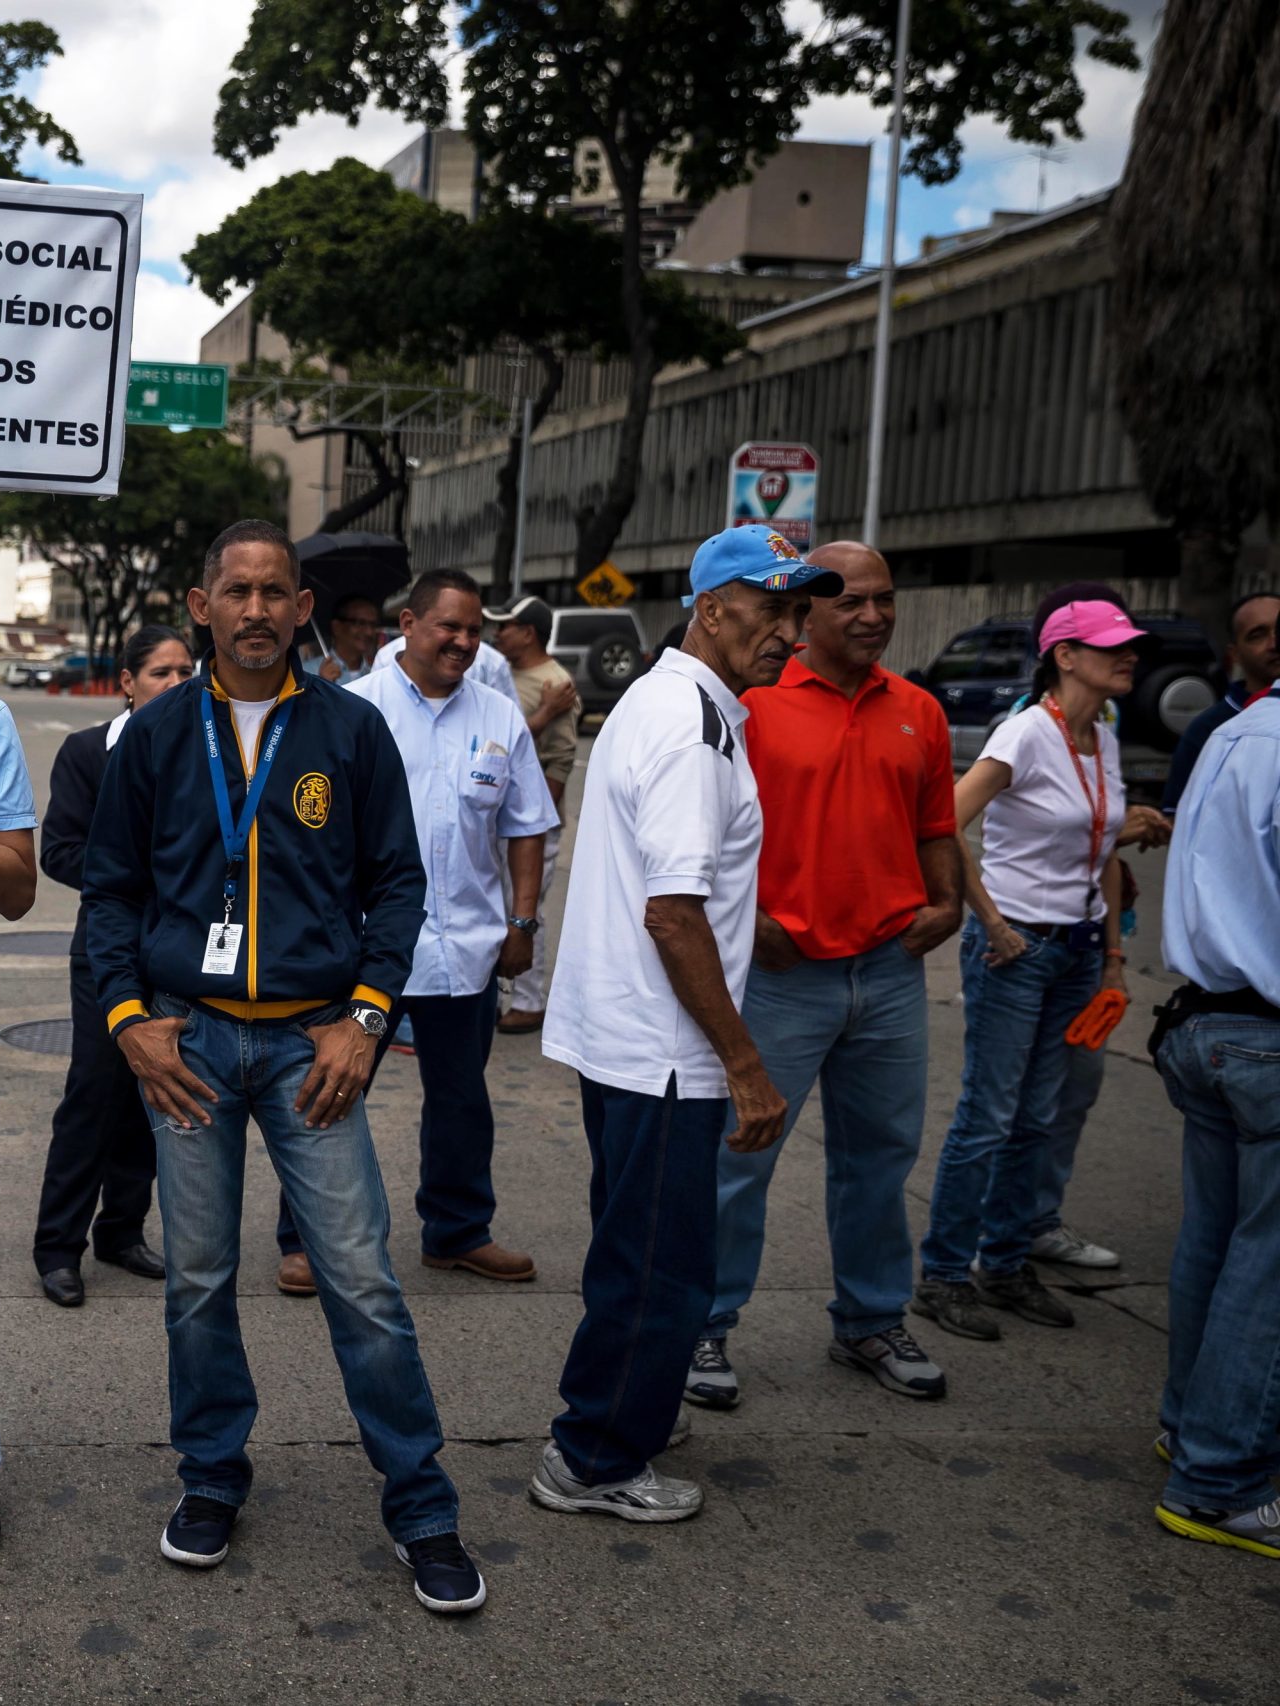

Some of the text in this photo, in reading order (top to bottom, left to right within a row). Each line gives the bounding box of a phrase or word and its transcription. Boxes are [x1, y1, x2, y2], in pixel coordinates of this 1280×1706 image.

[130, 367, 221, 386] DRES BELLO
[206, 719, 218, 758] CORPOELEC
[264, 725, 283, 761] CORPOELEC
